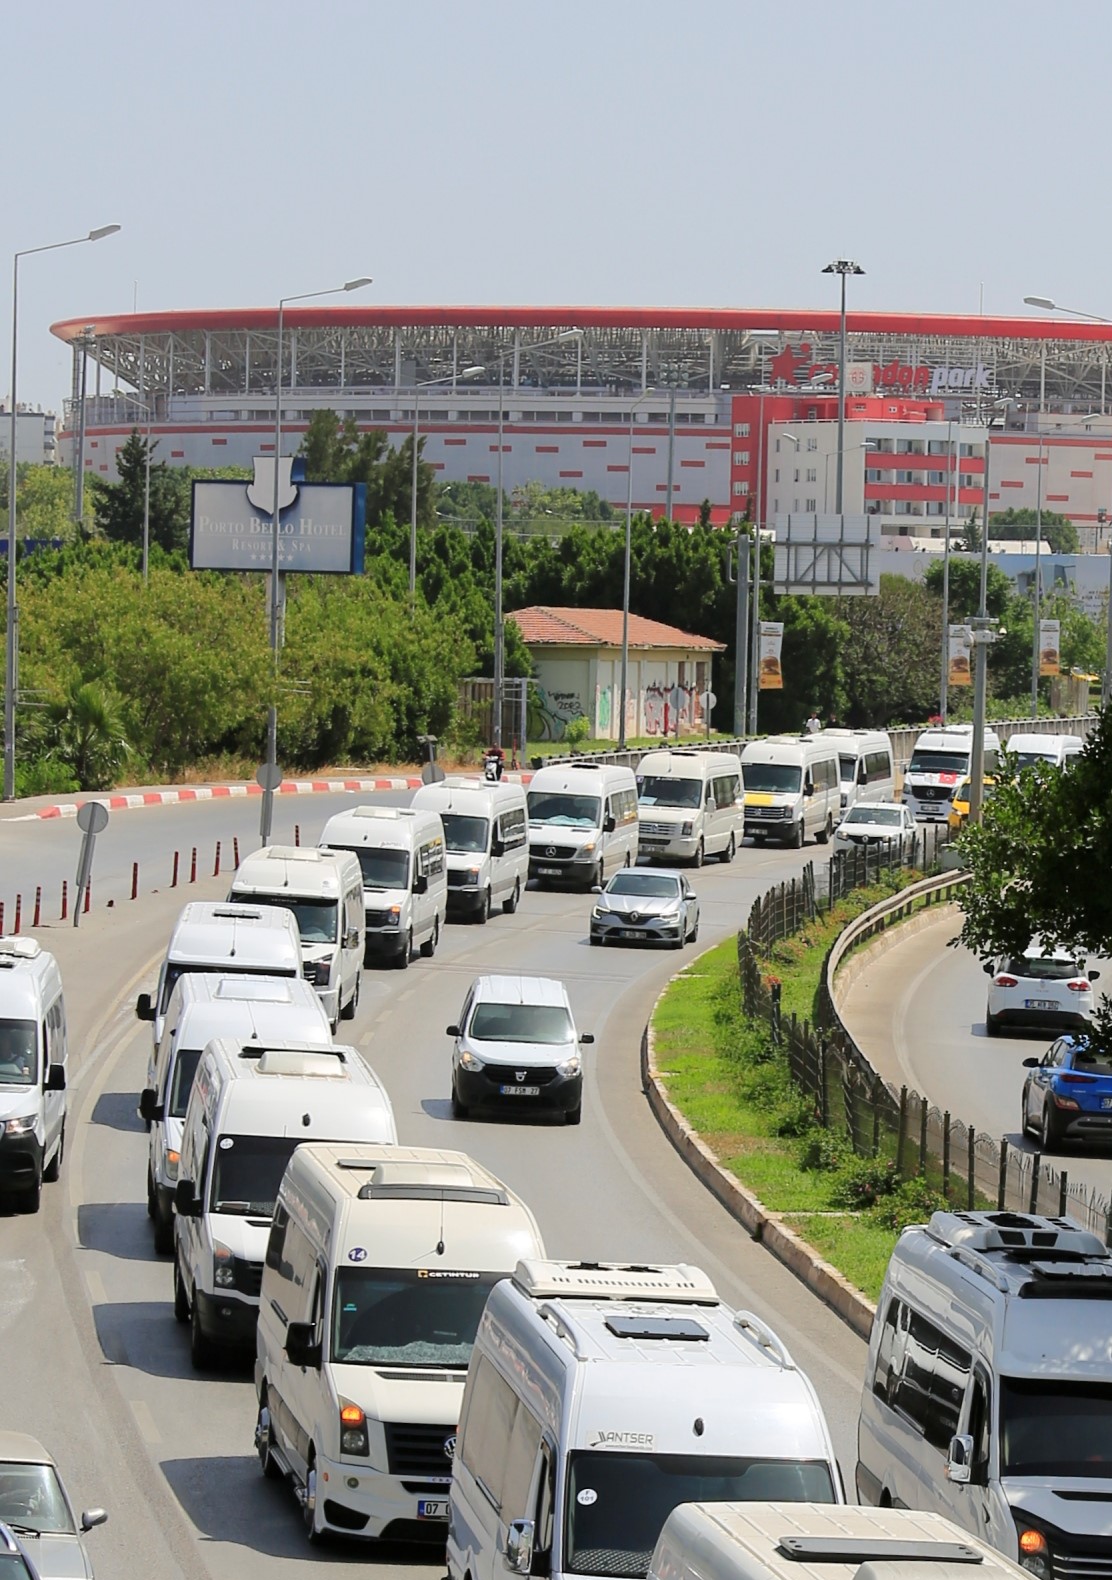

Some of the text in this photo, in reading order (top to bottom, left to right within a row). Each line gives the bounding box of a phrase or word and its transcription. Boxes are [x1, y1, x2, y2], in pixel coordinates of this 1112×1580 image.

[930, 362, 991, 394] park
[350, 1249, 365, 1260] 14
[425, 1503, 439, 1515] 07
